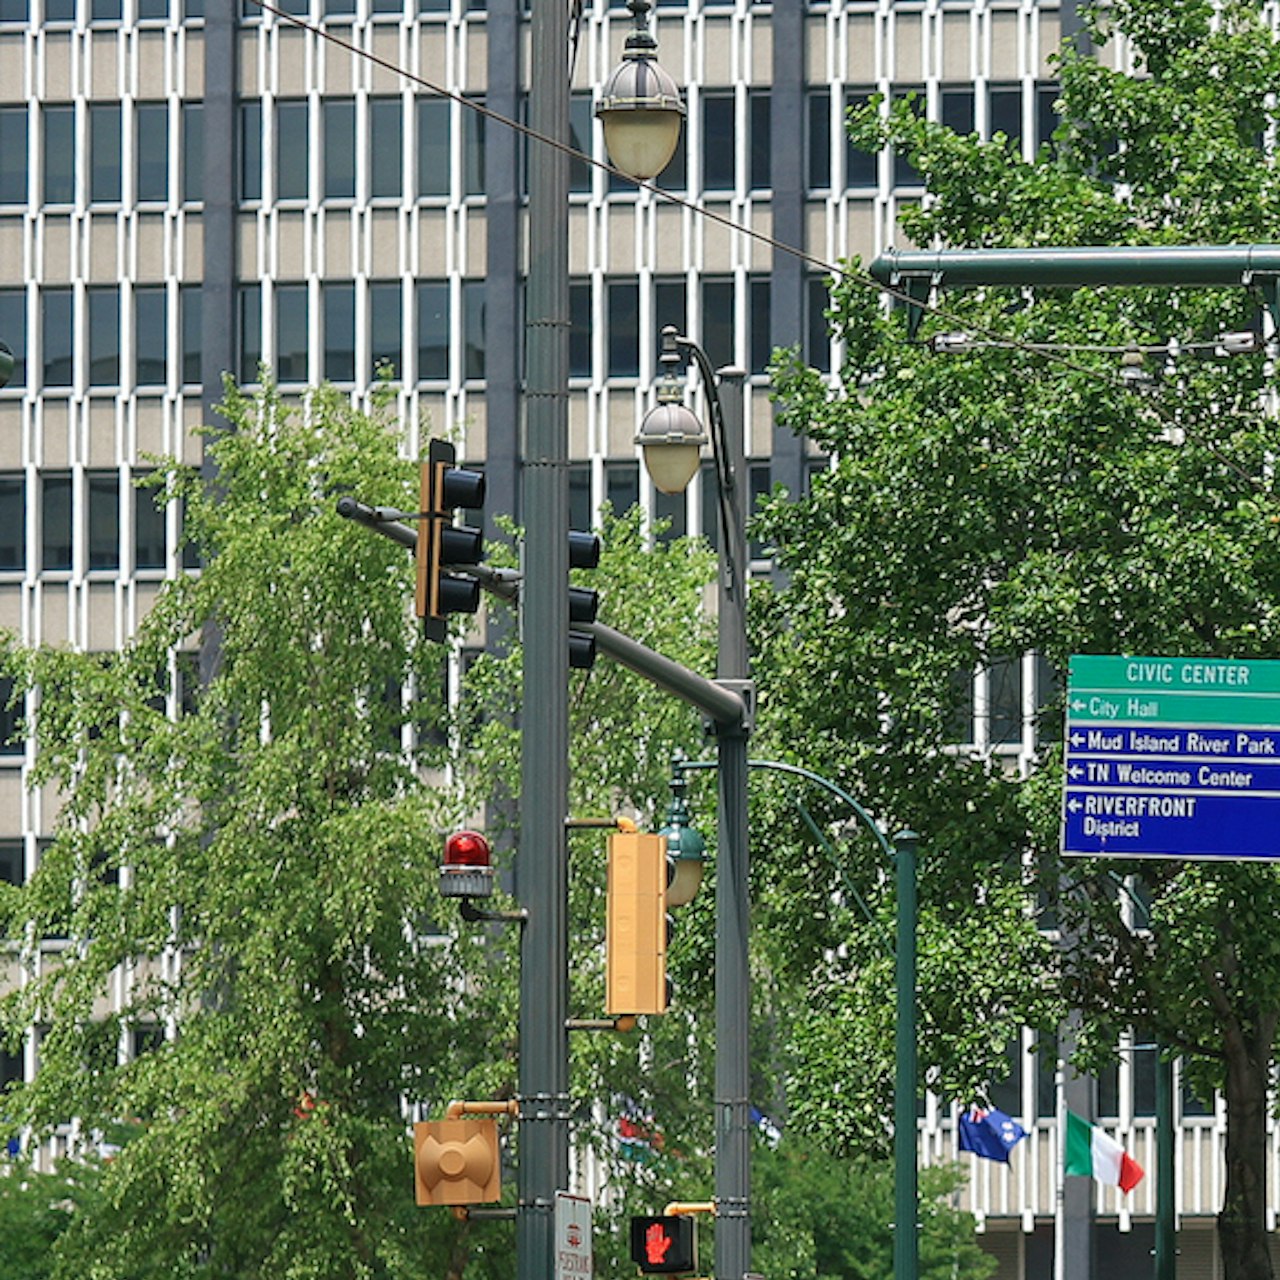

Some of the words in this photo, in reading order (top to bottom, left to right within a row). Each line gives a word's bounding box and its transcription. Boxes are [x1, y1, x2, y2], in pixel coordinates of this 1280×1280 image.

[1126, 663, 1173, 683] CIVIC
[1181, 665, 1249, 685] CENTER
[1089, 697, 1120, 718] City
[1128, 698, 1158, 717] Hall
[1087, 730, 1122, 750] Mud
[1130, 731, 1179, 752] Island
[1187, 732, 1229, 753] River
[1236, 734, 1275, 754] Park
[1087, 763, 1110, 782] TN
[1117, 764, 1191, 785] Welcome
[1198, 766, 1252, 787] Center
[1084, 795, 1196, 817] RIVERFRONT
[1083, 816, 1140, 838] District
